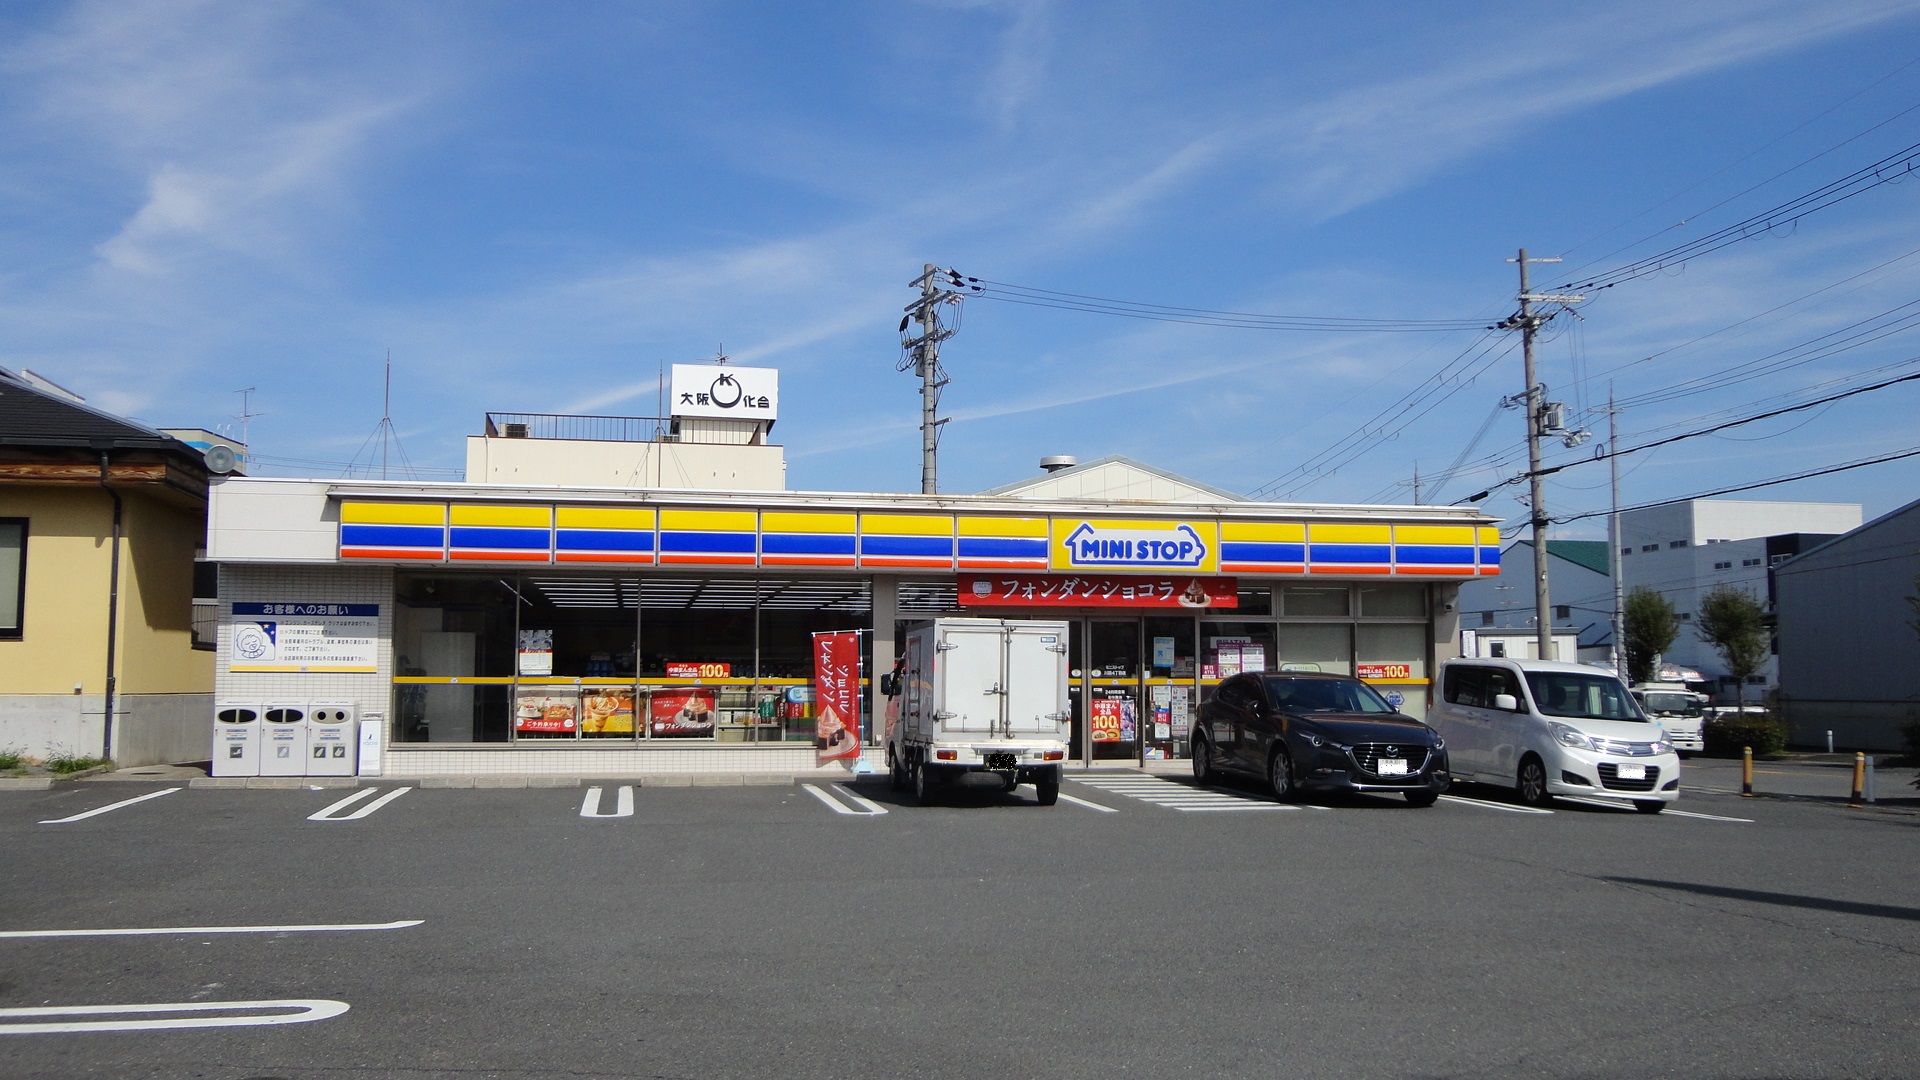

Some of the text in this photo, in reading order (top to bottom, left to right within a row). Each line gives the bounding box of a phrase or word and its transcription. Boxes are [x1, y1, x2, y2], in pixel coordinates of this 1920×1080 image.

[680, 393, 709, 406] 大阪
[1082, 539, 1194, 560] MINI STOP
[1001, 577, 1175, 600] フォンダンショコラ
[263, 604, 349, 615] お客様へのお願い
